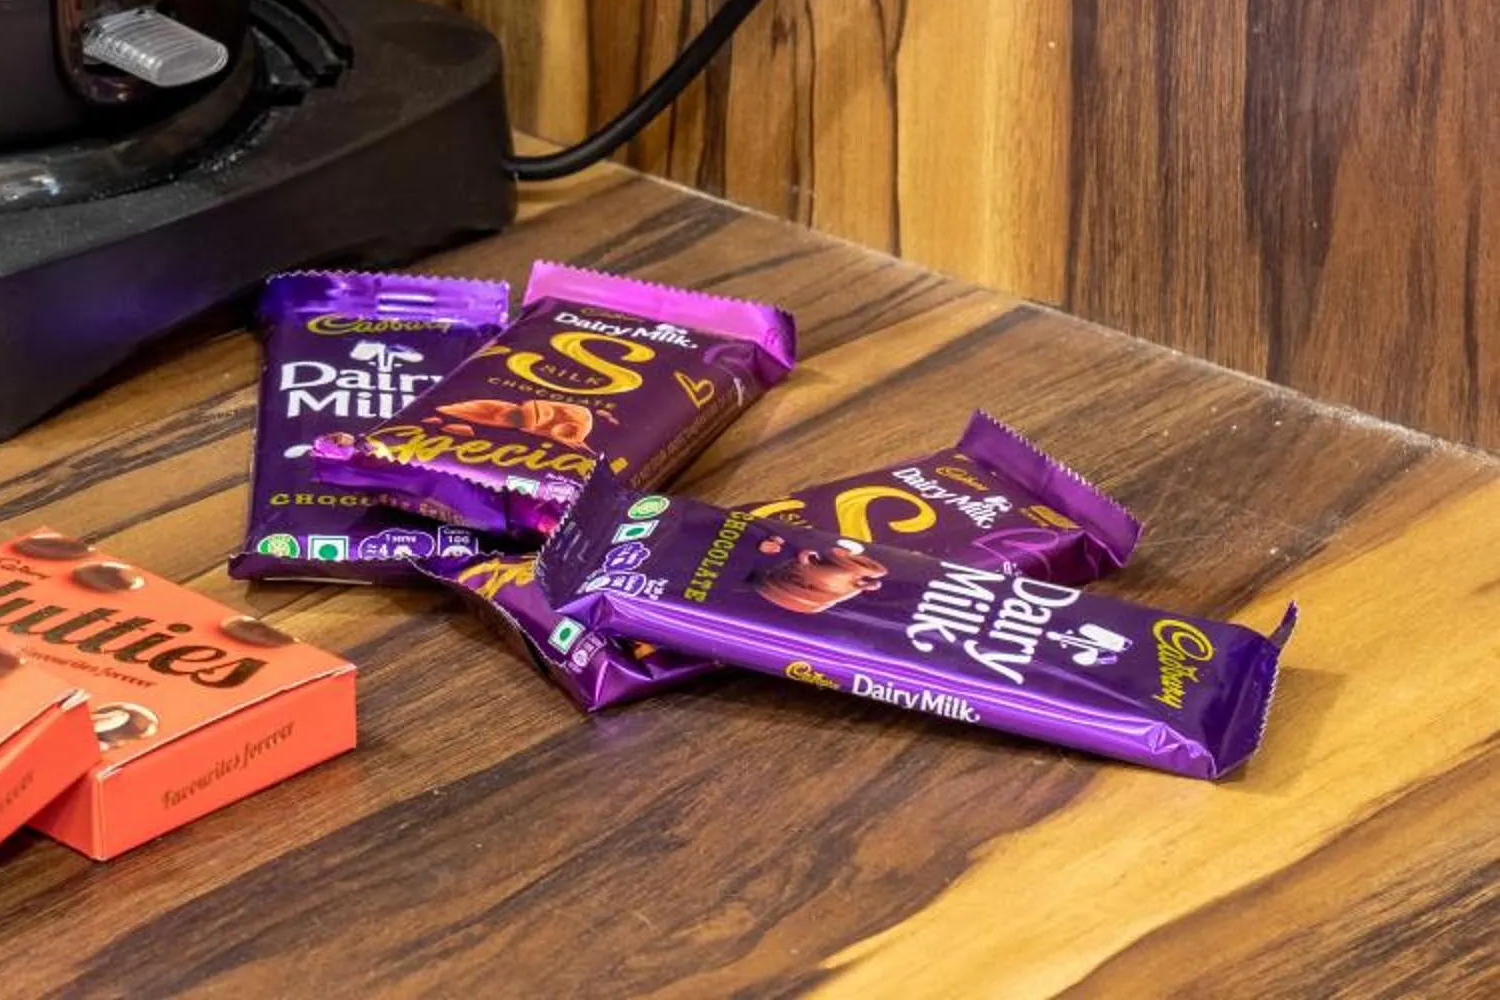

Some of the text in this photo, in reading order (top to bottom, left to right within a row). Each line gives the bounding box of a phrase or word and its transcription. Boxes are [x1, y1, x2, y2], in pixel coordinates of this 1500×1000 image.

[307, 313, 451, 335] Cadbury
[553, 311, 698, 349] Dairy Milk
[365, 424, 628, 479] Specia
[892, 467, 956, 499] Dairy
[684, 511, 754, 603] CHOCOLATE
[905, 561, 1007, 653] Milk
[966, 576, 1082, 686] Dairy
[852, 673, 920, 710] Dairy
[919, 690, 981, 723] Milk
[1151, 617, 1215, 710] Cadbury
[160, 720, 296, 811] Favourites forever
